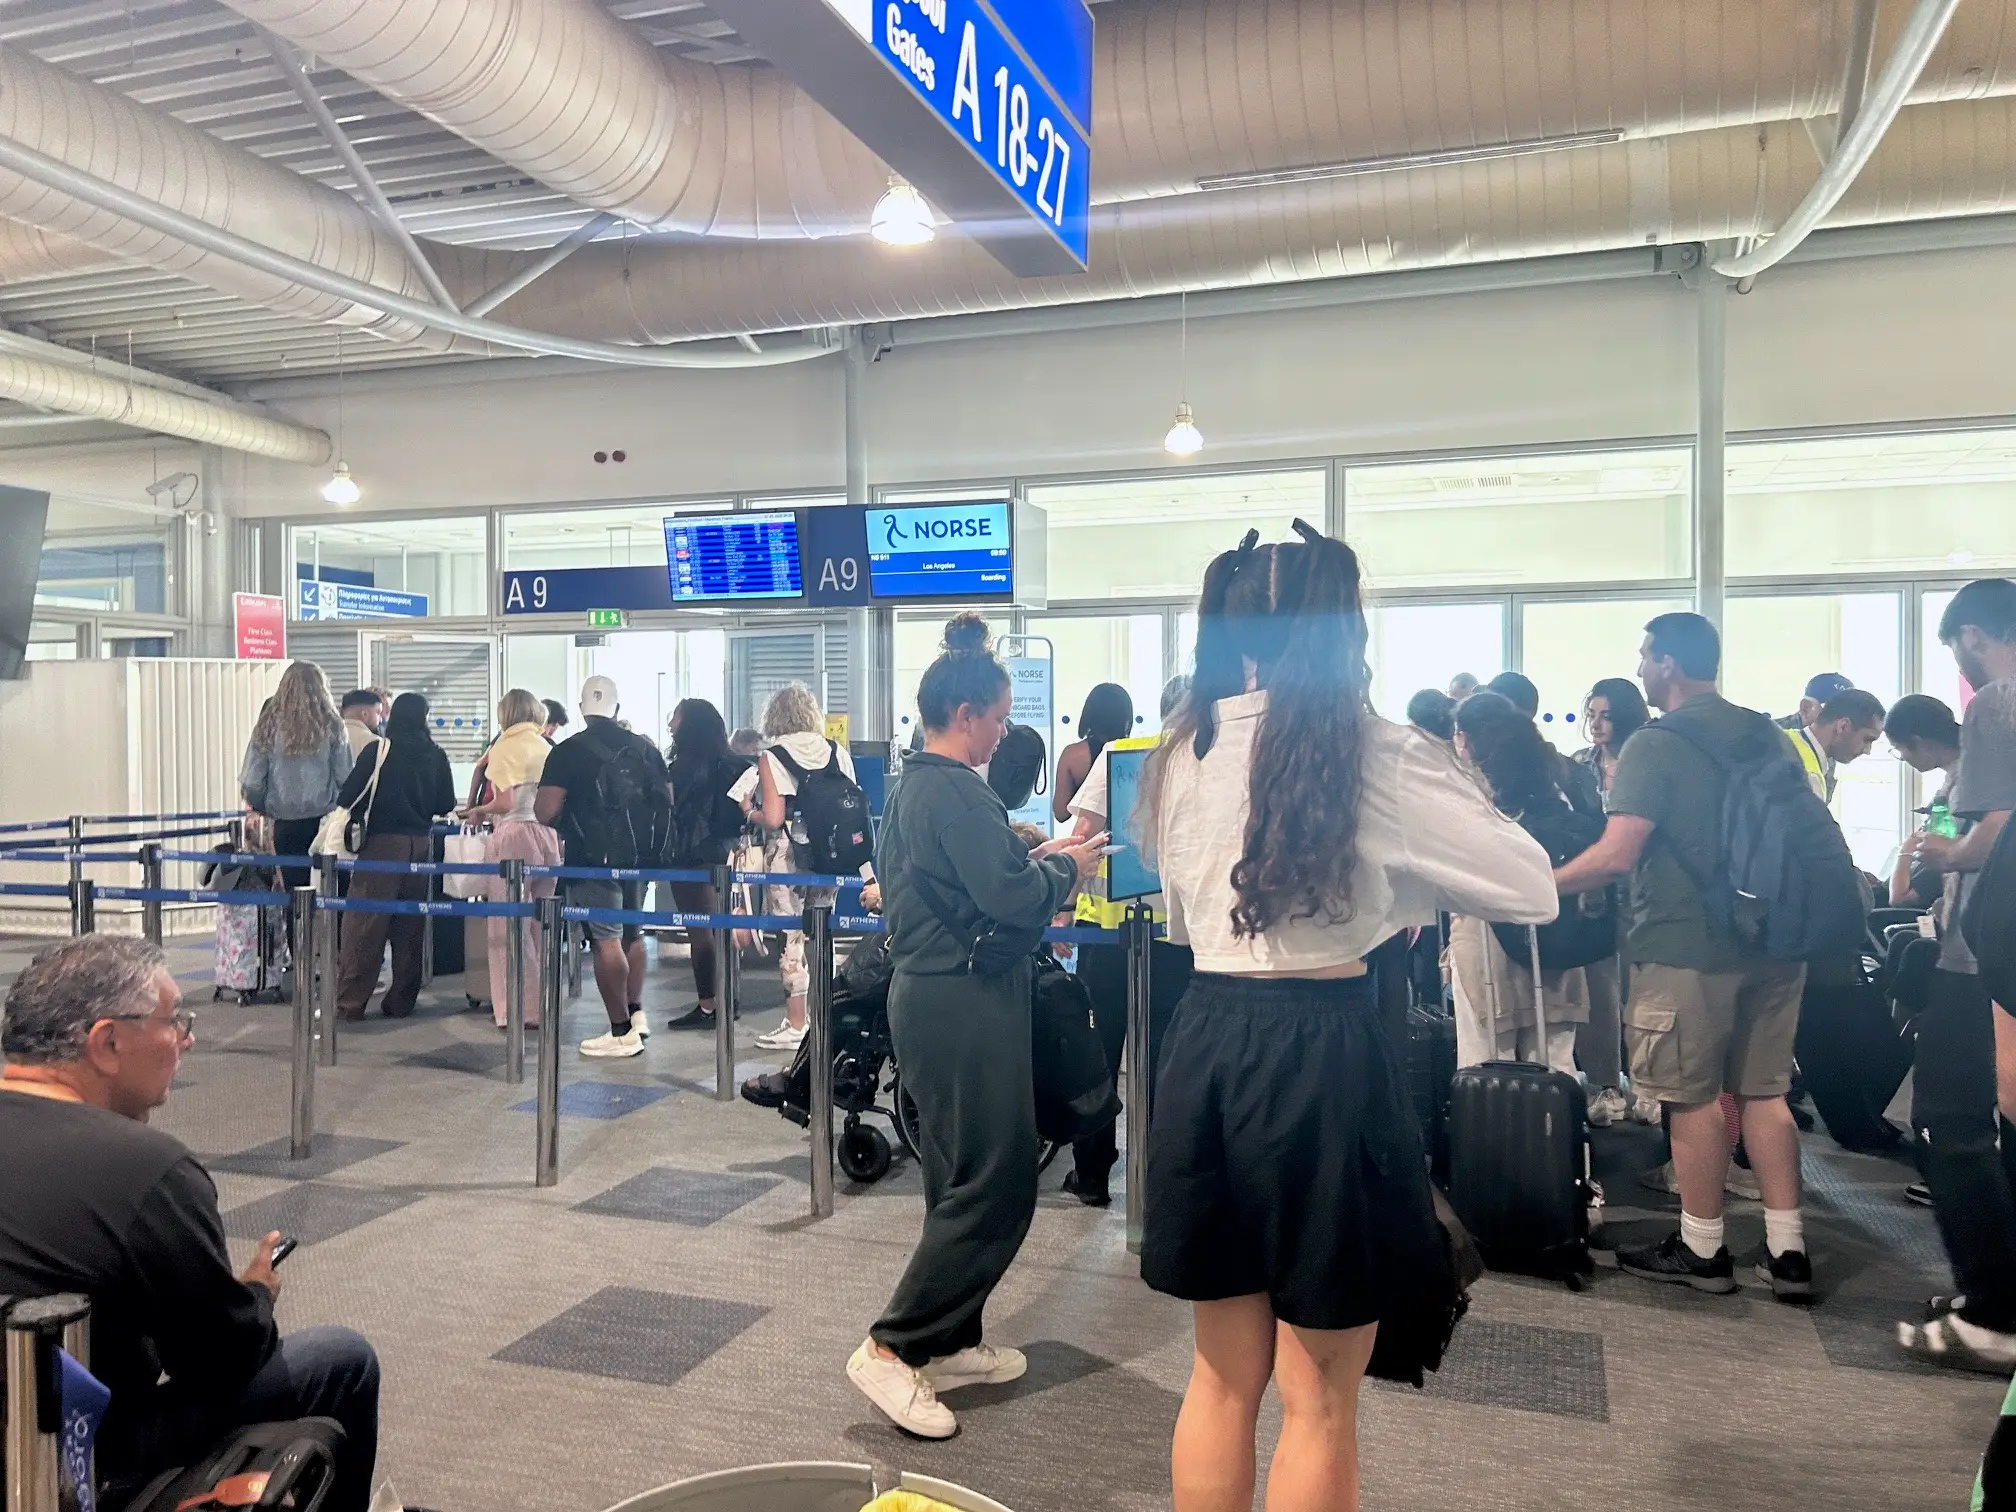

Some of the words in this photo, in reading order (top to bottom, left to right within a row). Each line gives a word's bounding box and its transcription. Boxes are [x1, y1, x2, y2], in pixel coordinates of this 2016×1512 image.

[886, 3, 935, 91] Gates
[952, 20, 981, 142] A
[994, 66, 1070, 226] 18-27
[914, 518, 992, 538] NORSE
[818, 557, 858, 591] A9
[933, 562, 955, 570] Angeles
[1018, 669, 1043, 678] NORSE
[564, 907, 589, 915] ATHENS
